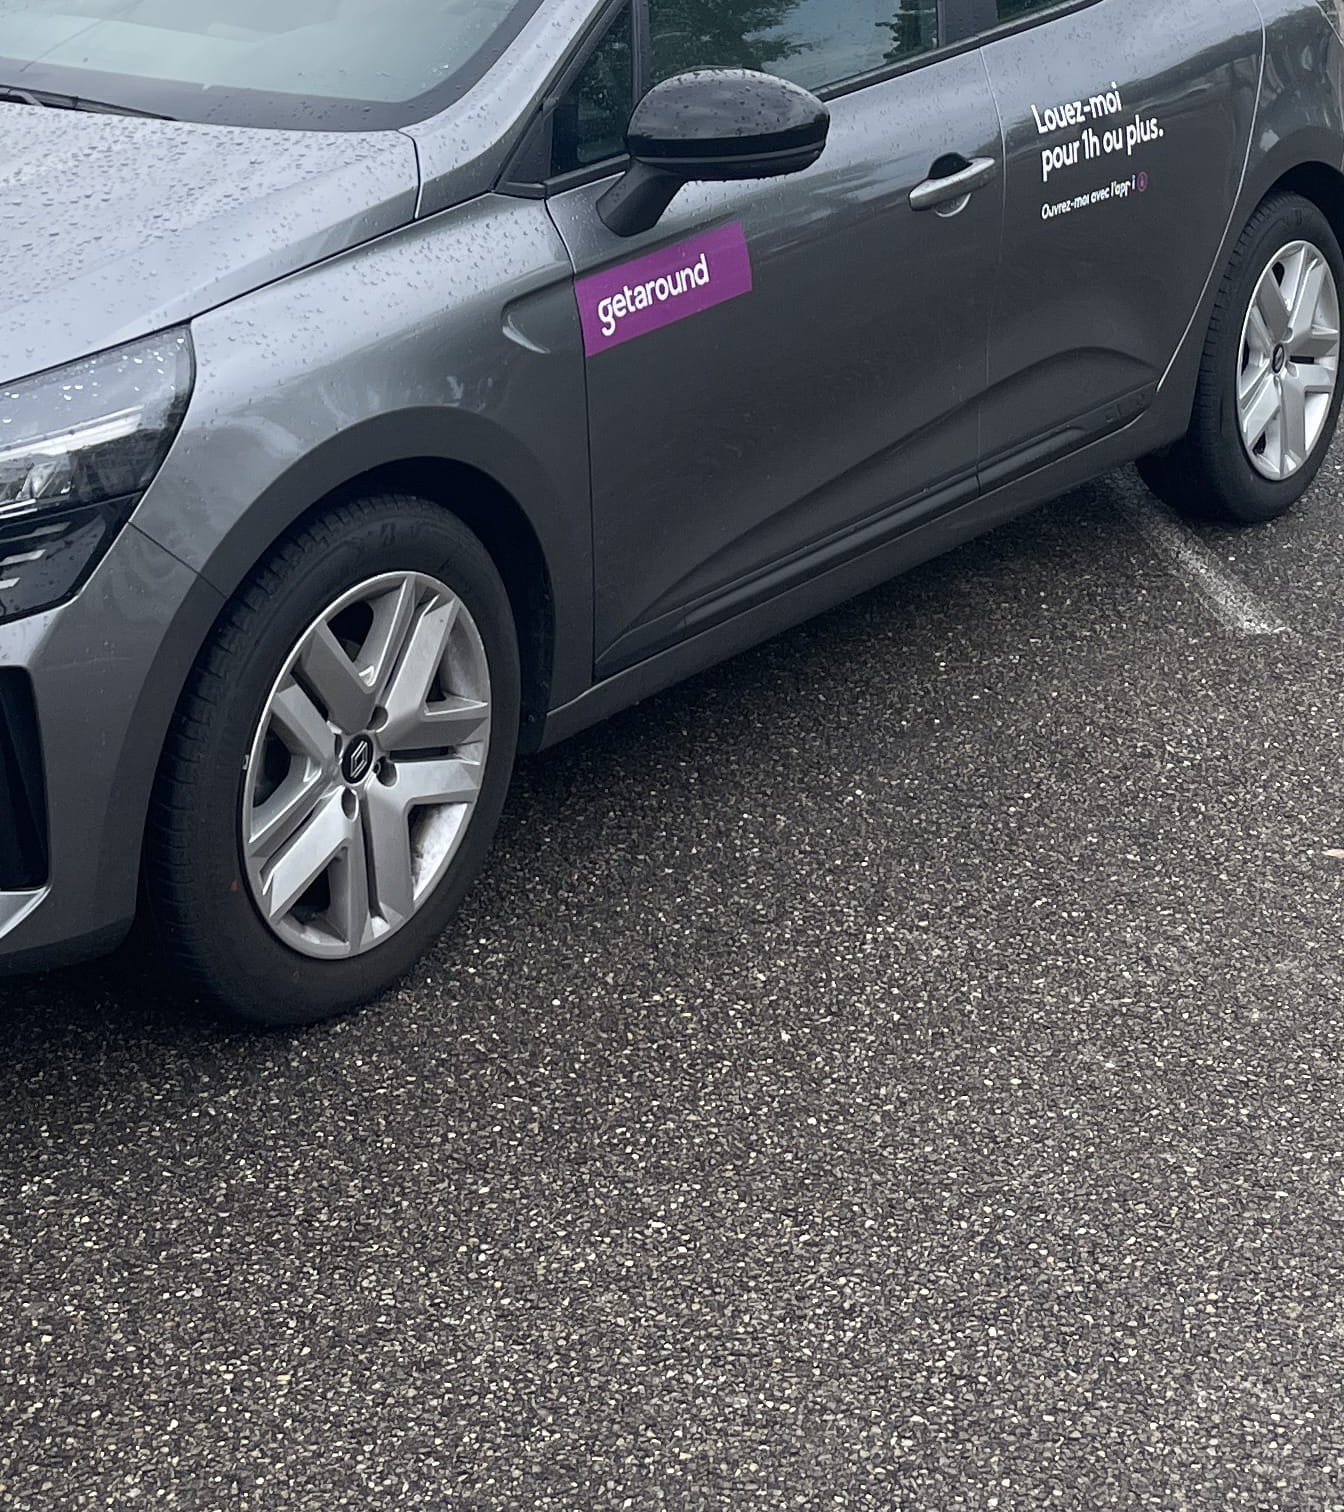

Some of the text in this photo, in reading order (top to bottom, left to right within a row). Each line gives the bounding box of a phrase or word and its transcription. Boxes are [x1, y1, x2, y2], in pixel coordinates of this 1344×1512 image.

[1030, 81, 1122, 134] Louez-moi
[1041, 114, 1164, 182] pour 1h ou plus.
[1041, 194, 1090, 220] Ouvrez-moi
[1090, 187, 1110, 203] avec
[597, 253, 710, 336] getaround
